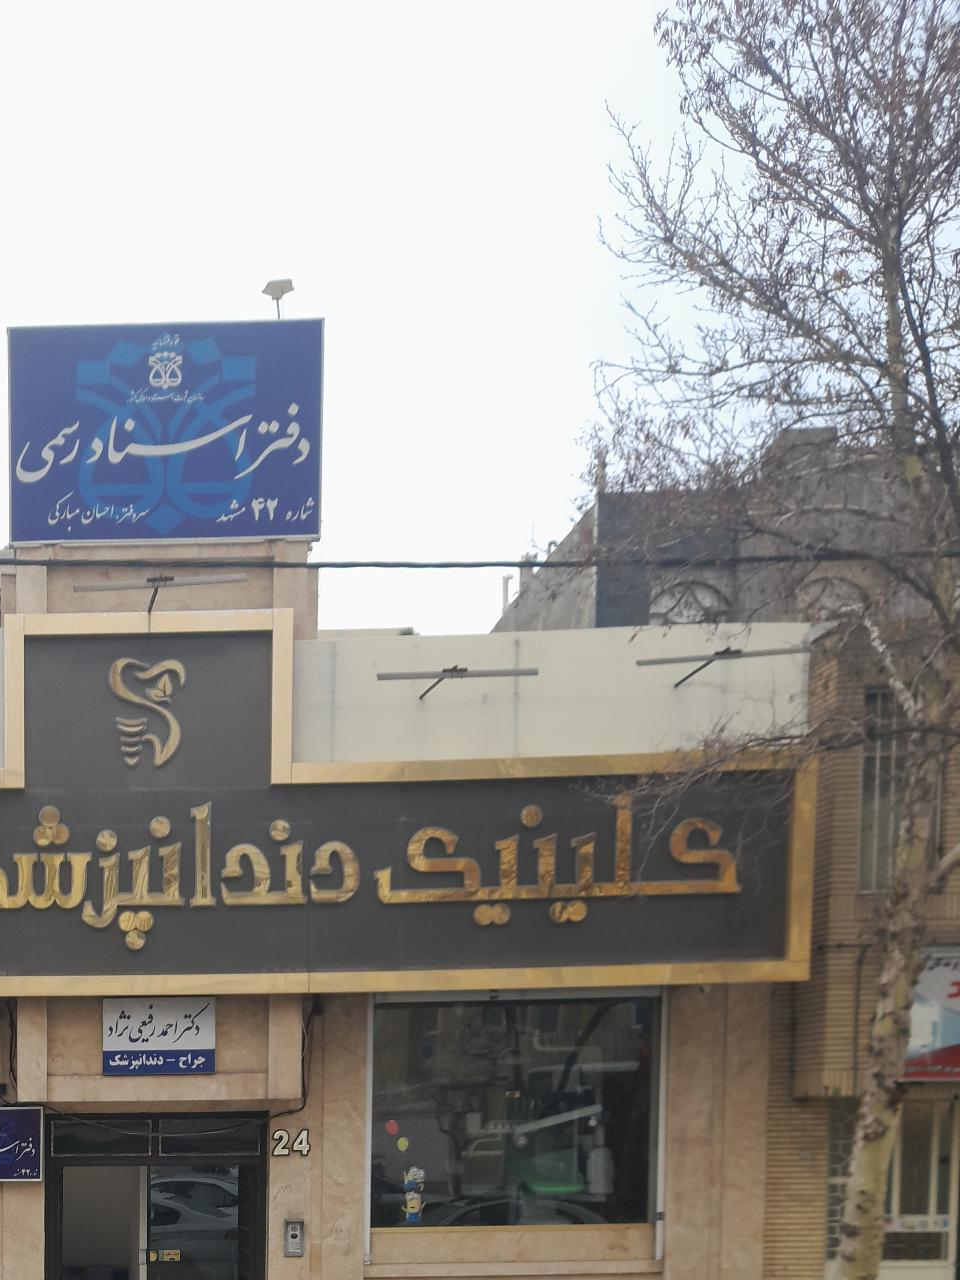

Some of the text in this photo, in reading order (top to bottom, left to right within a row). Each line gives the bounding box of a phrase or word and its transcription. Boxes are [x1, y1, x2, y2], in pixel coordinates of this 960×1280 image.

[16, 402, 311, 484] دفتر اسناد رسمی
[47, 490, 80, 532] مبارکی
[80, 503, 114, 526] احسان
[215, 497, 315, 523] شماره ۴۲ مشهد
[372, 790, 742, 927] کلینیک
[107, 1002, 211, 1044] دکتر احمد رفیعی نژاد
[108, 1052, 164, 1070] دندانپزشک
[178, 1052, 206, 1069] جراح
[15, 1138, 36, 1161] دفتر
[272, 1128, 311, 1157] 24
